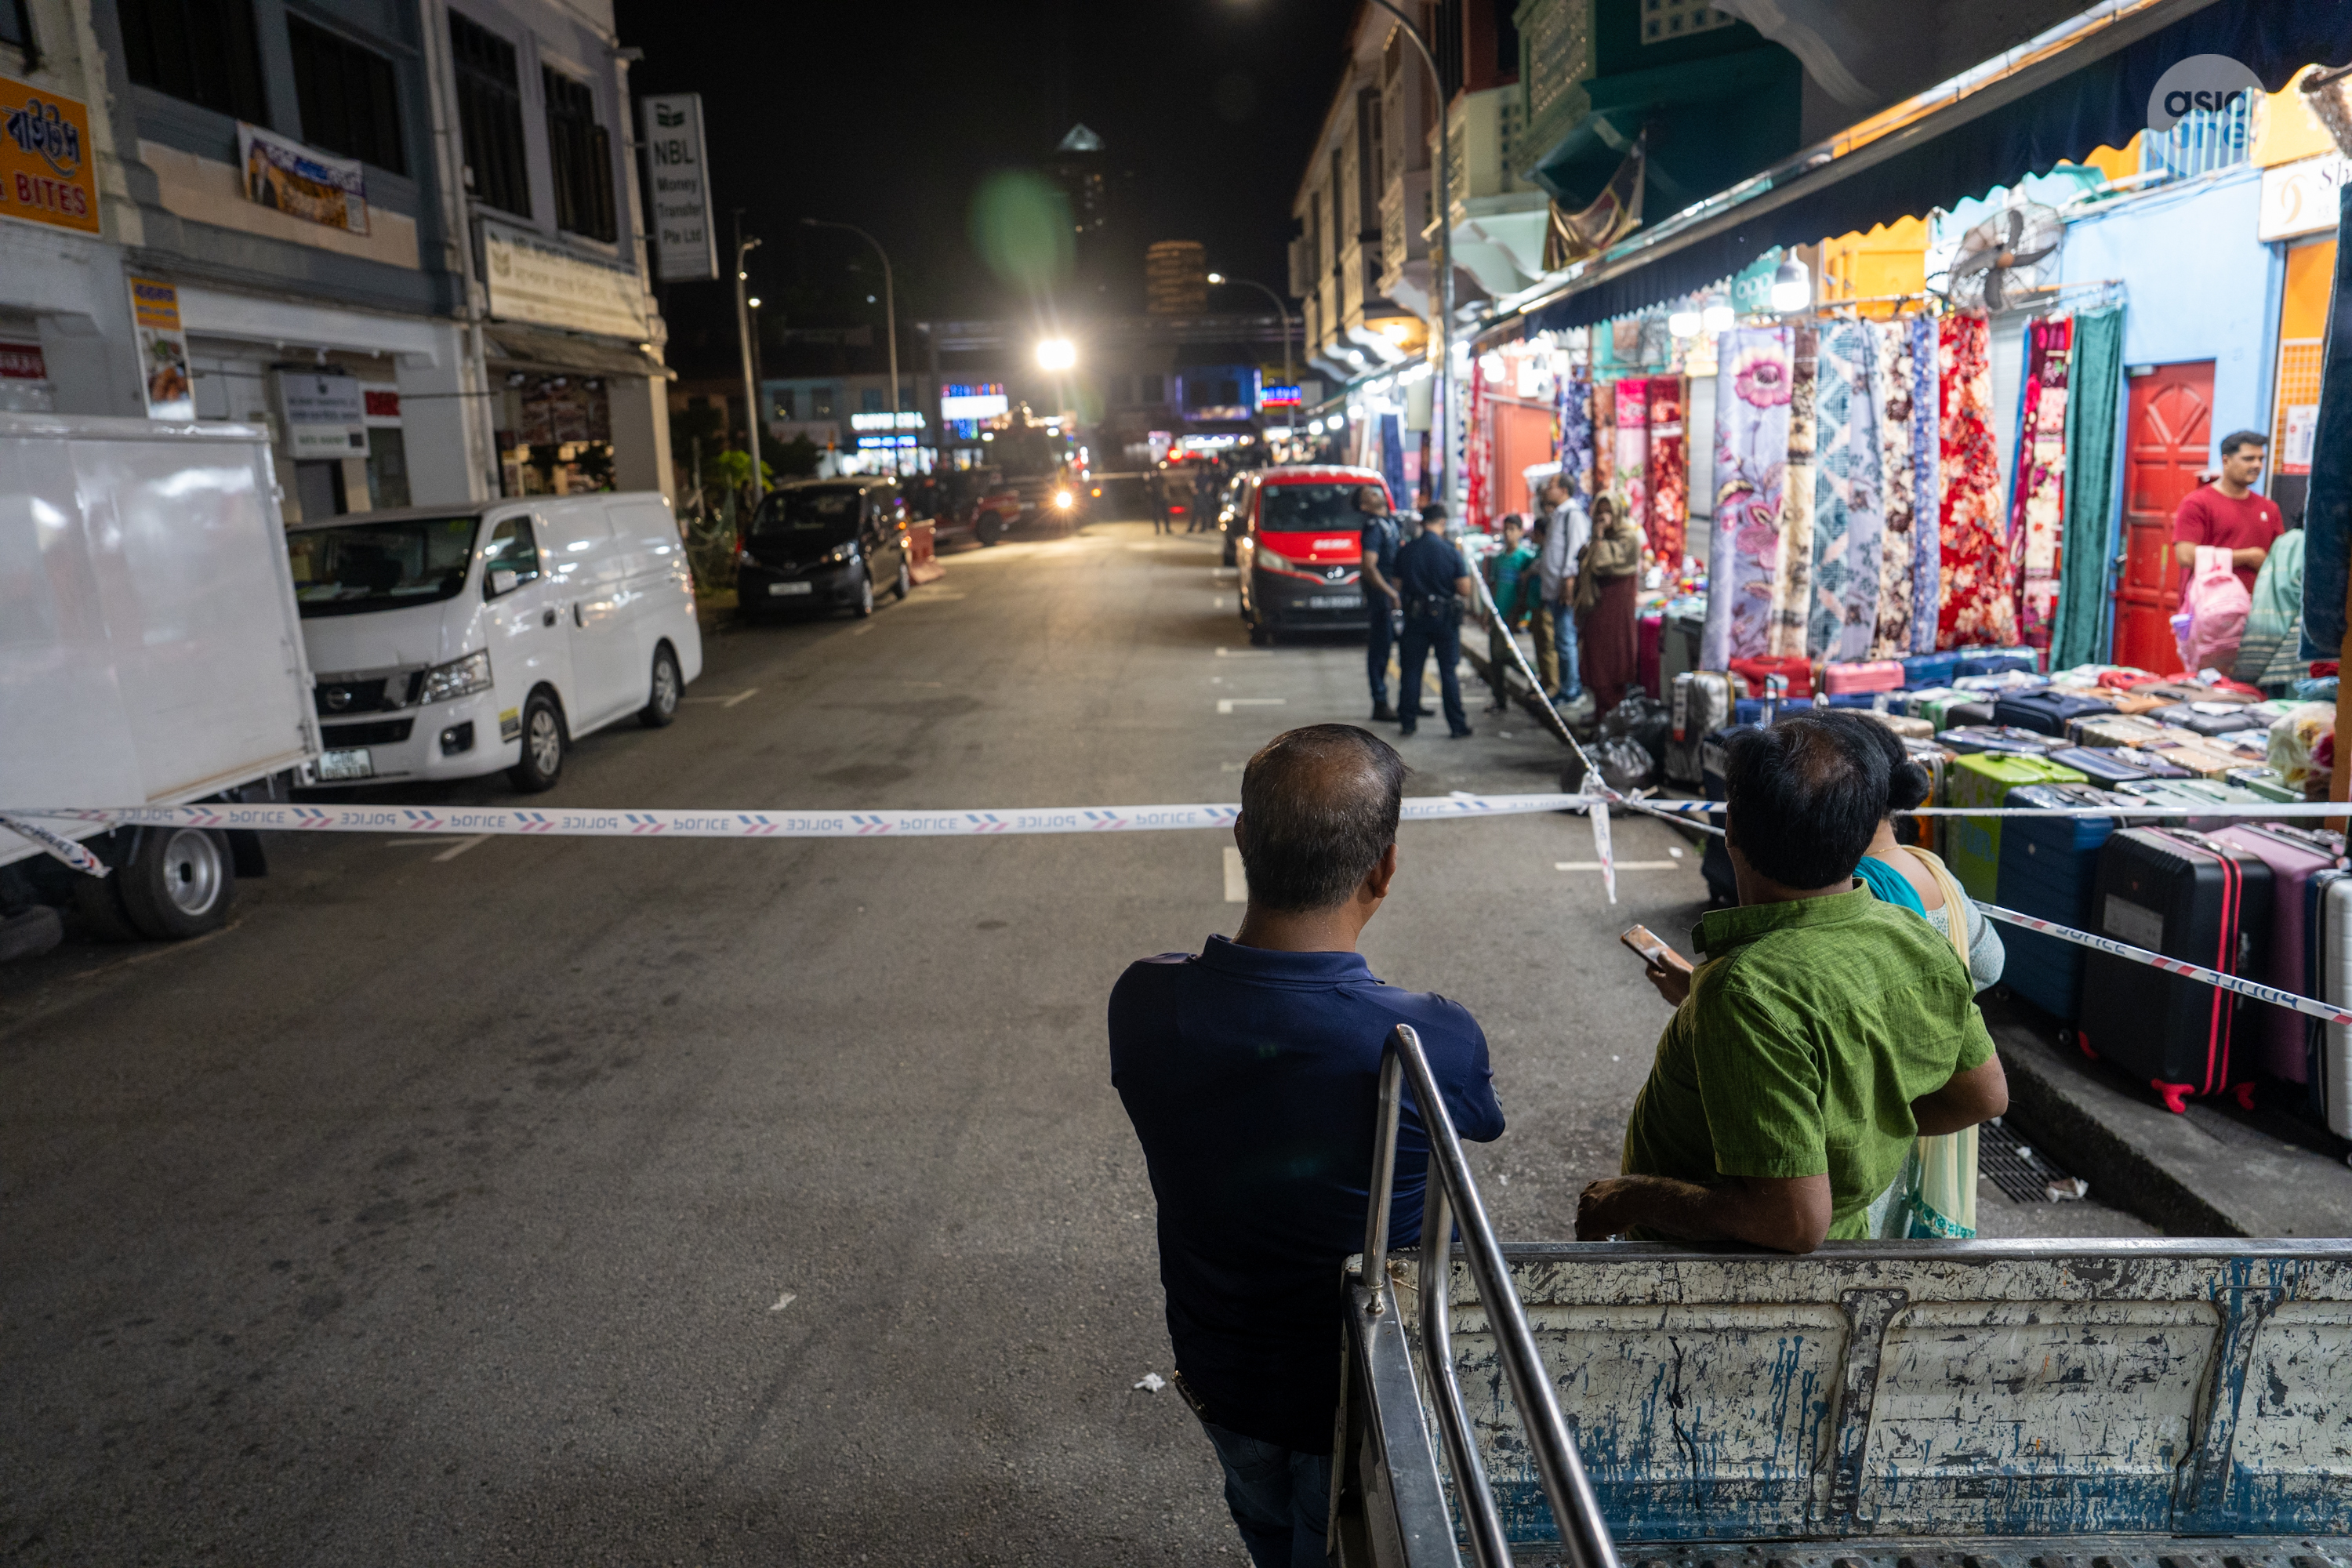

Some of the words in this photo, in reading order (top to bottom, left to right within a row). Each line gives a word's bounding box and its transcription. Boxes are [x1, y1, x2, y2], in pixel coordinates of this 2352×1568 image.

[654, 140, 695, 166] NBL
[14, 170, 89, 219] BITES
[656, 177, 698, 194] Money
[656, 201, 703, 219] Transfer
[684, 227, 703, 244] Ltd
